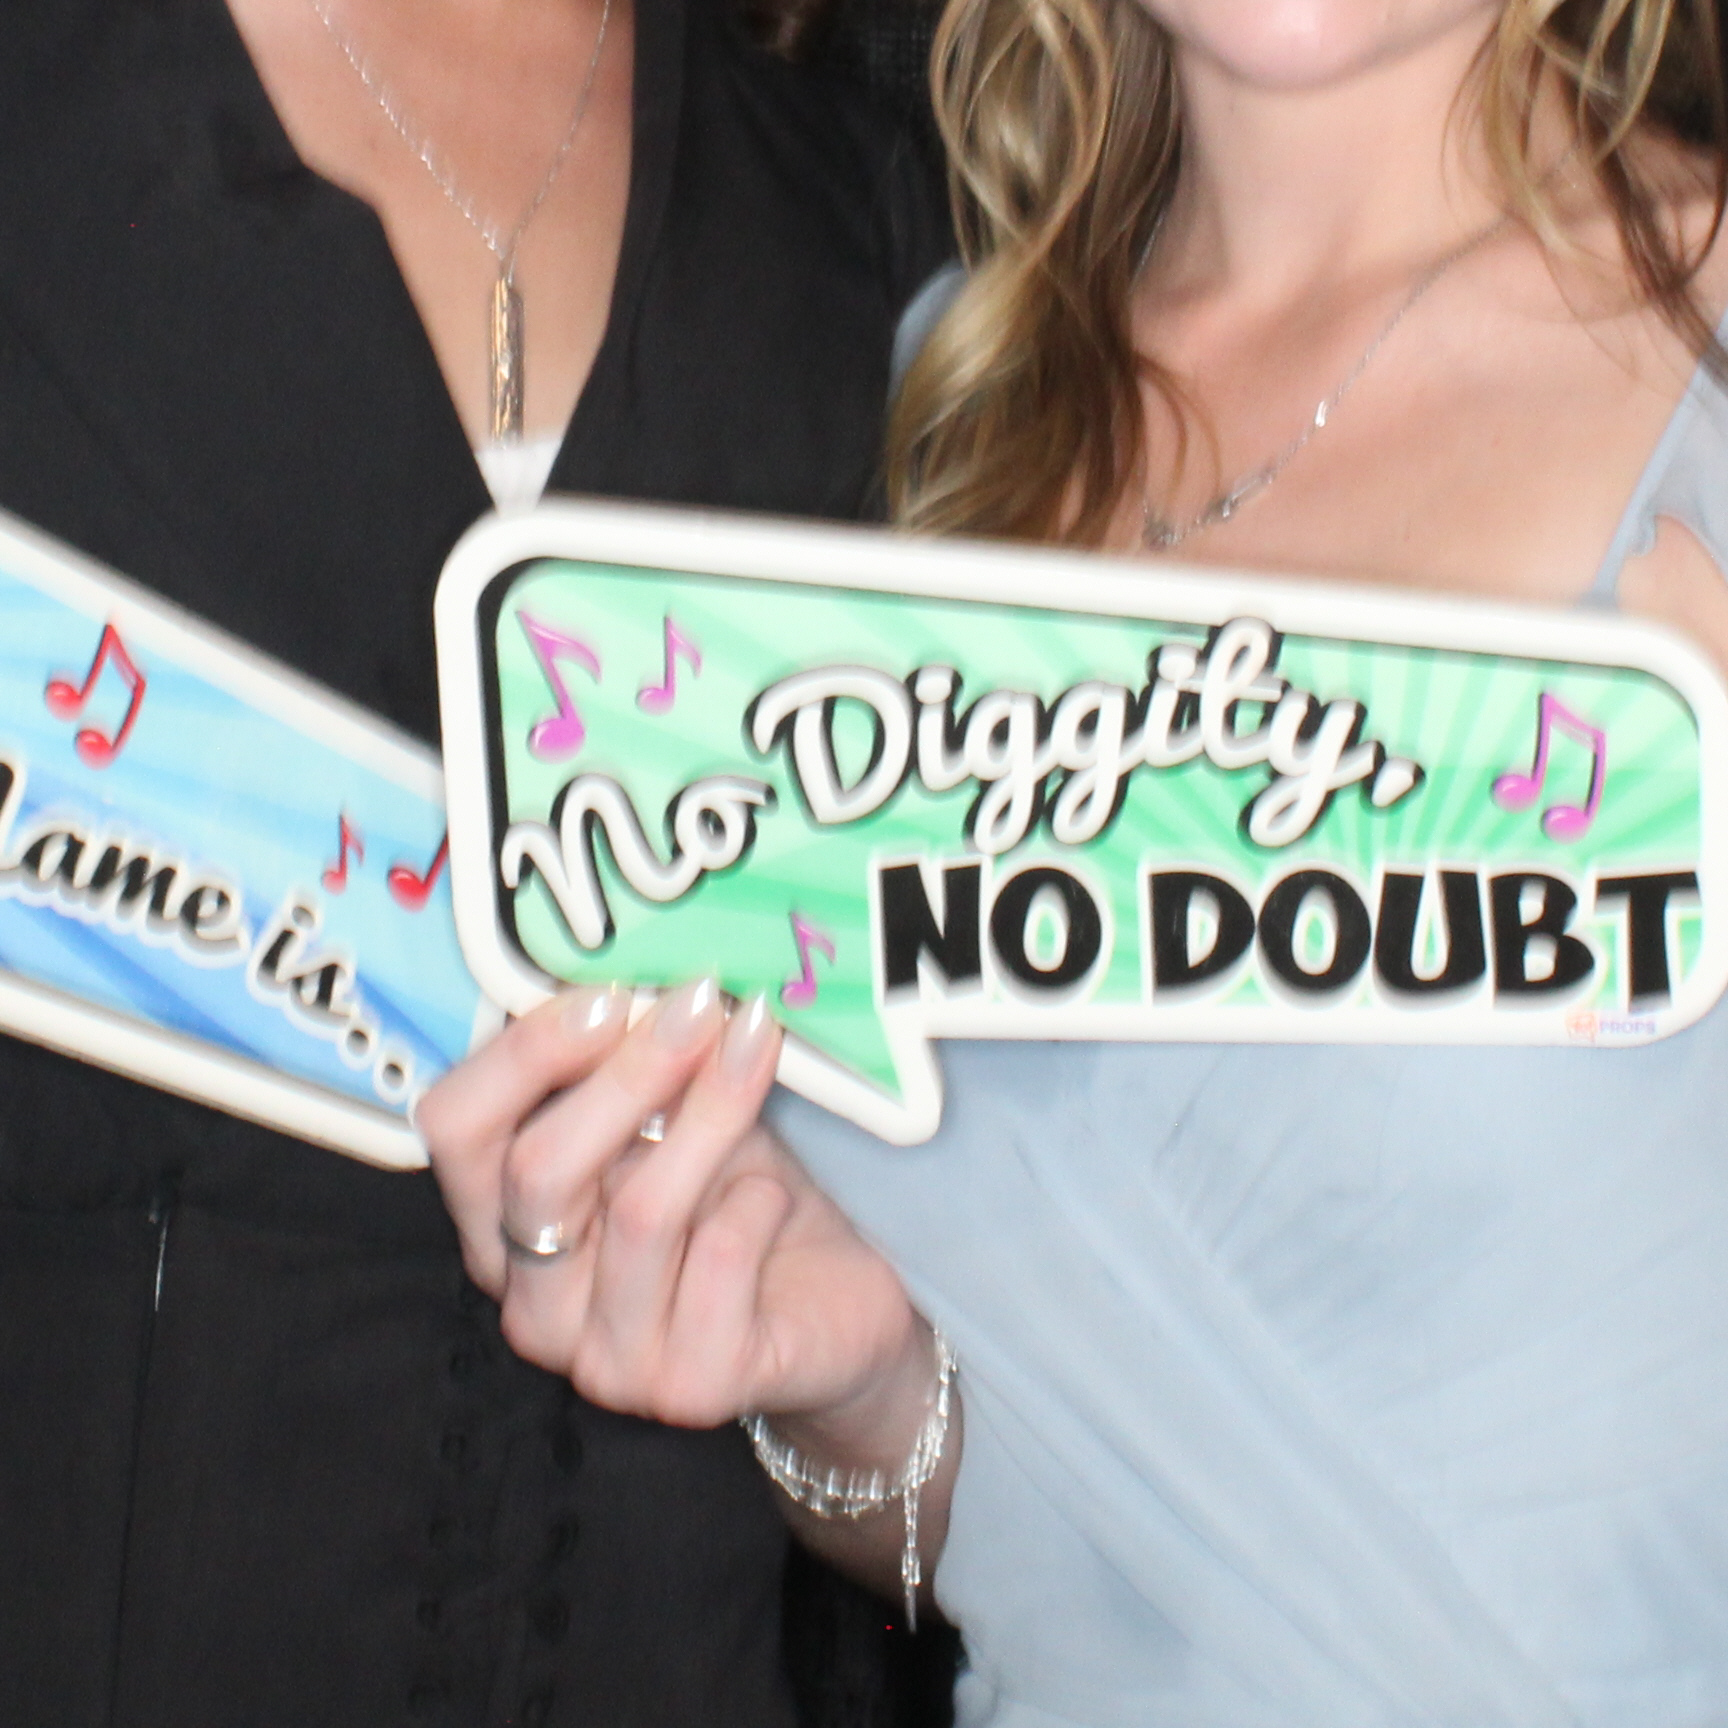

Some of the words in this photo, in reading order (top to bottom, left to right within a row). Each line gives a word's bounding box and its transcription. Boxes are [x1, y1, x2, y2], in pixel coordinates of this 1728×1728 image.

[500, 774, 776, 952] No
[745, 616, 1422, 854] Diggity,
[256, 904, 414, 1096] is..
[877, 862, 1104, 1006] NO
[1147, 862, 1702, 1012] DOUBT
